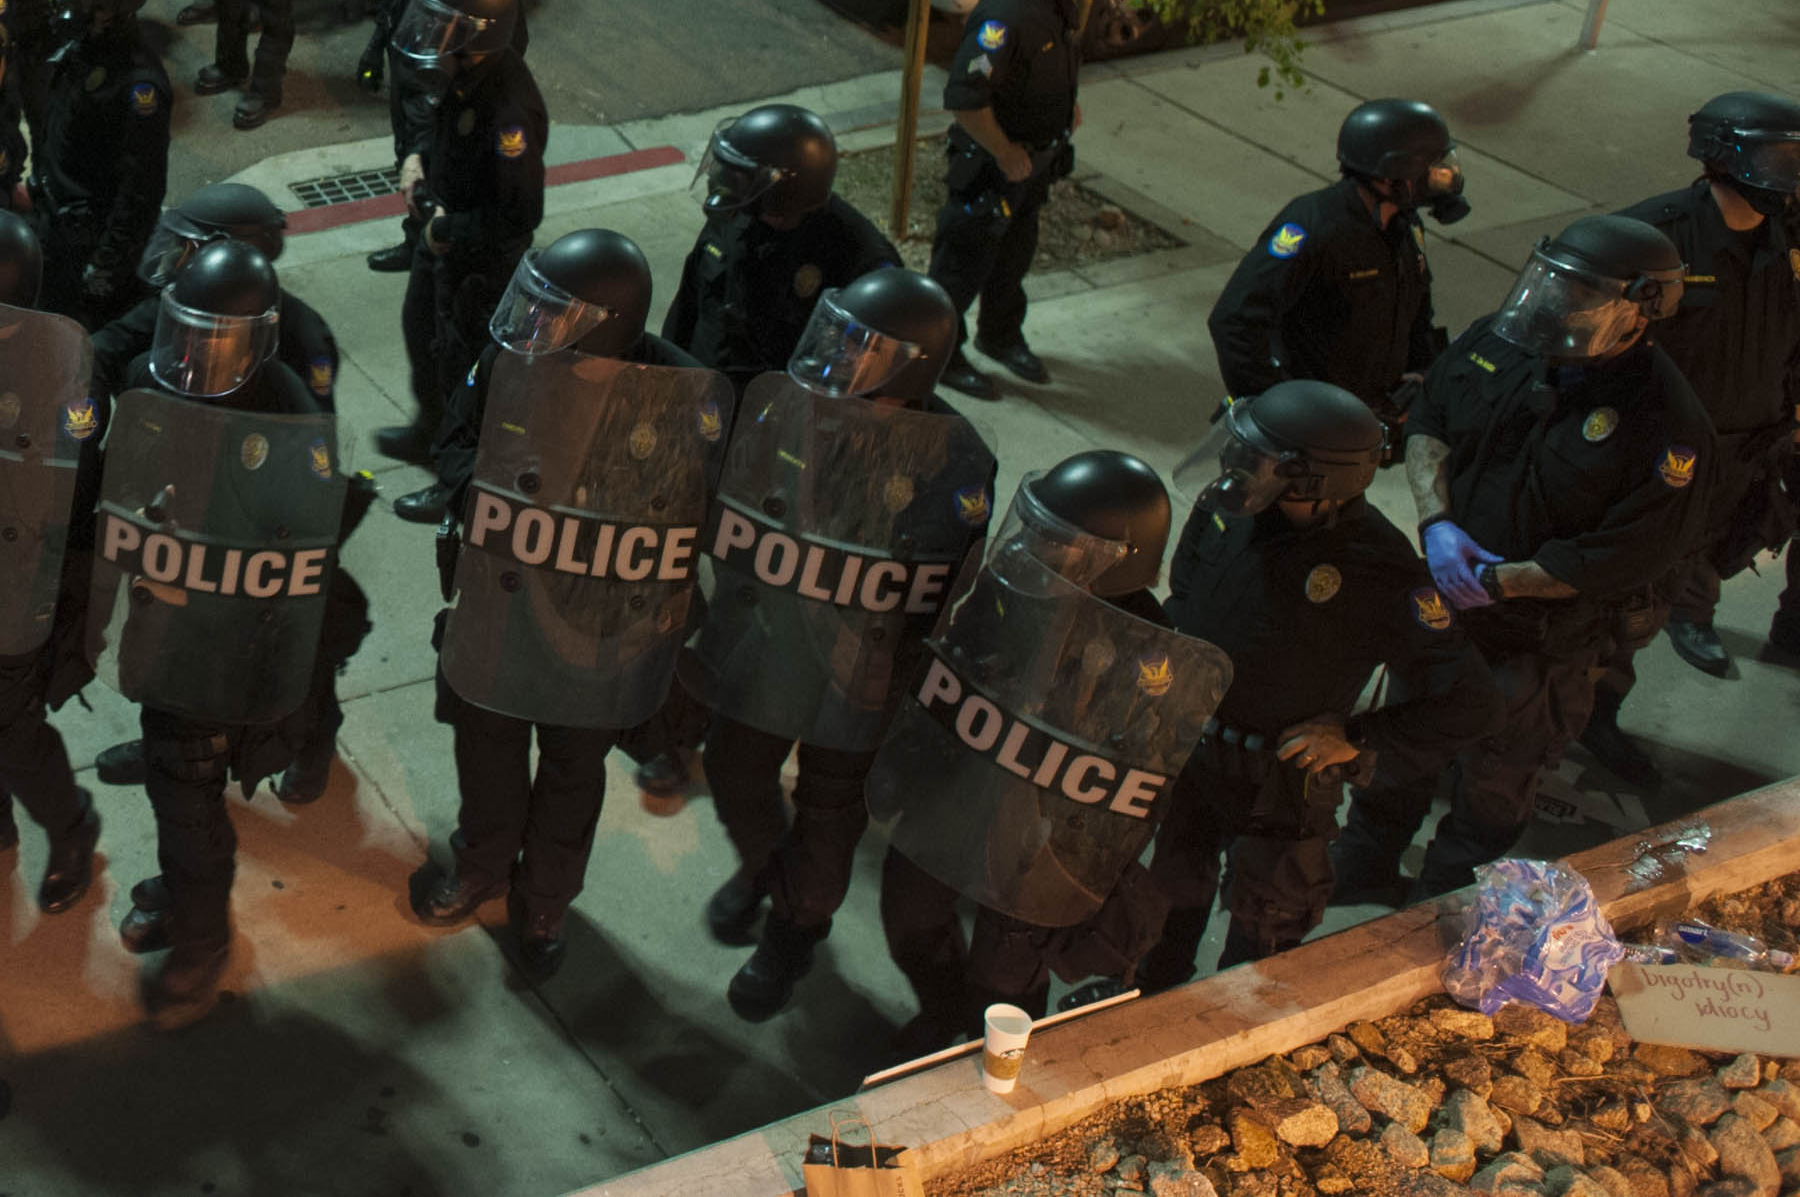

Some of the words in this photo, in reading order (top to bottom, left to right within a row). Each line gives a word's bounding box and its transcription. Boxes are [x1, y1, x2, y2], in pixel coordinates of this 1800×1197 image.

[103, 518, 328, 599] POLICE
[470, 494, 698, 580] POLICE
[712, 514, 952, 616] POLICE
[918, 658, 1168, 820] POLICE
